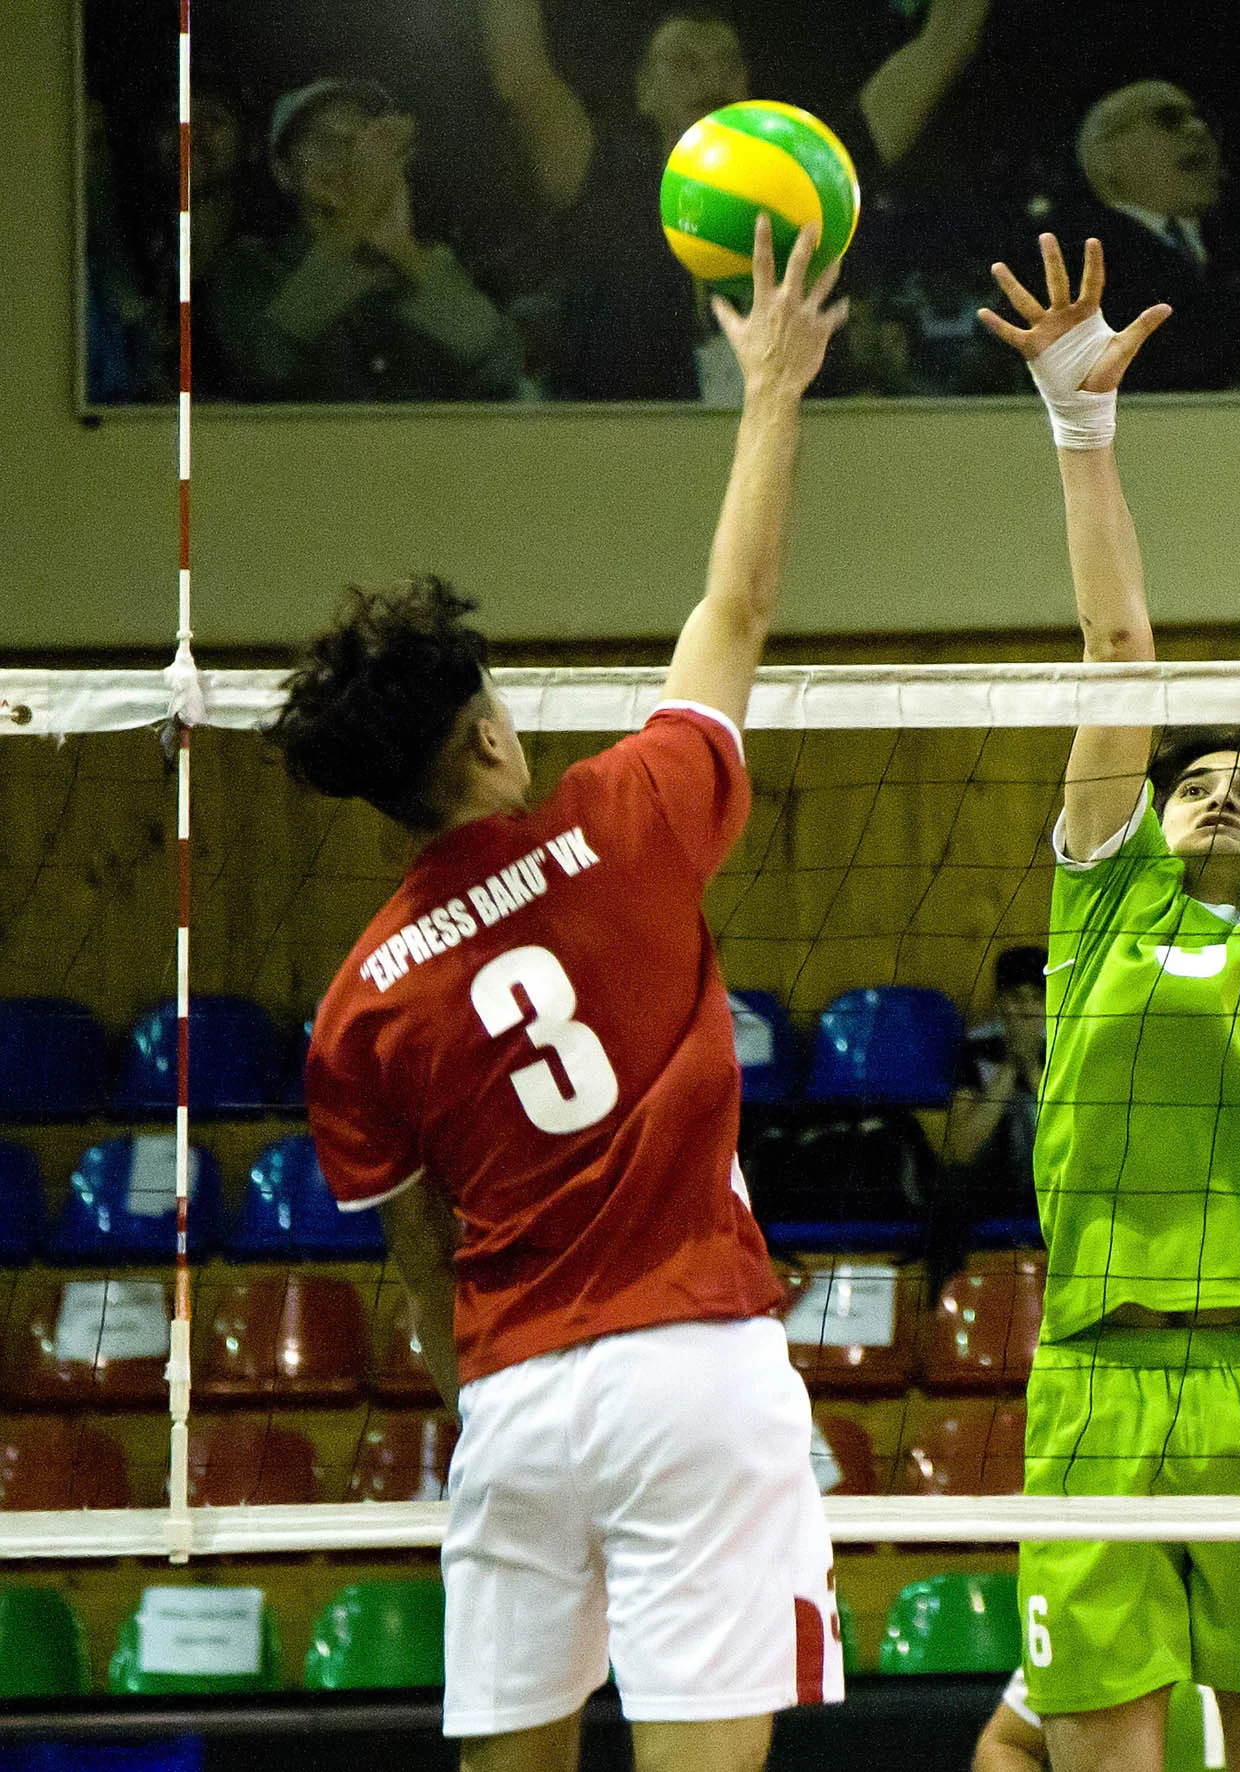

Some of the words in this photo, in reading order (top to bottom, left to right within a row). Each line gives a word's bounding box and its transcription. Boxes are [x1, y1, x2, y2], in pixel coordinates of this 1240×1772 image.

[545, 826, 600, 878] VK
[470, 945, 619, 1135] 3
[1028, 1594, 1052, 1668] 6
